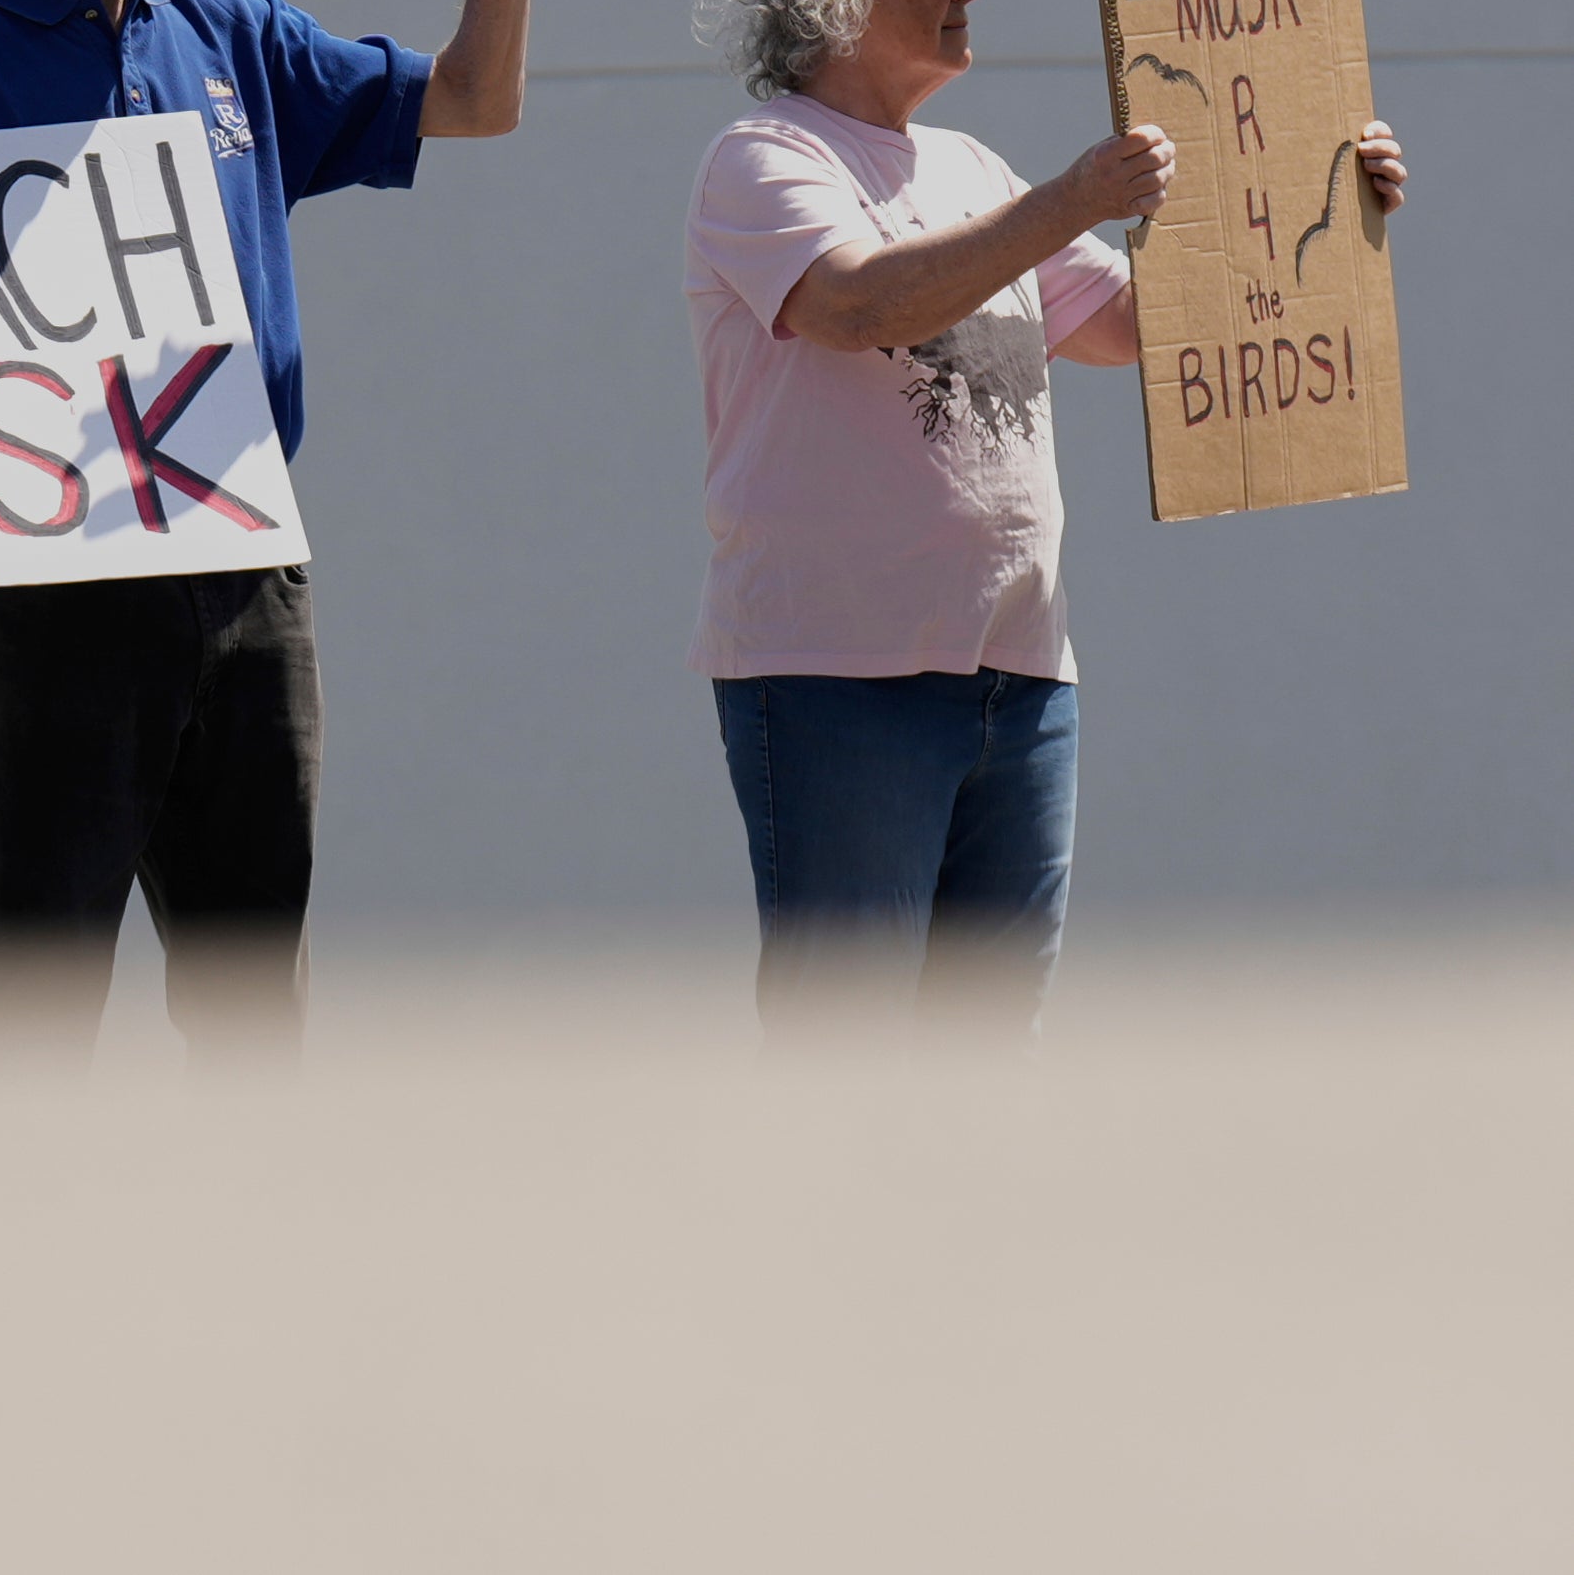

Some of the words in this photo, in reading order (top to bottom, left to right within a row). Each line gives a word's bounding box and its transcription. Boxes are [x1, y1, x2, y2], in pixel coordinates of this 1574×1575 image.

[1232, 74, 1265, 155] R
[1245, 187, 1276, 261] 4
[1245, 278, 1284, 325] the
[1178, 324, 1356, 428] BIRDS!
